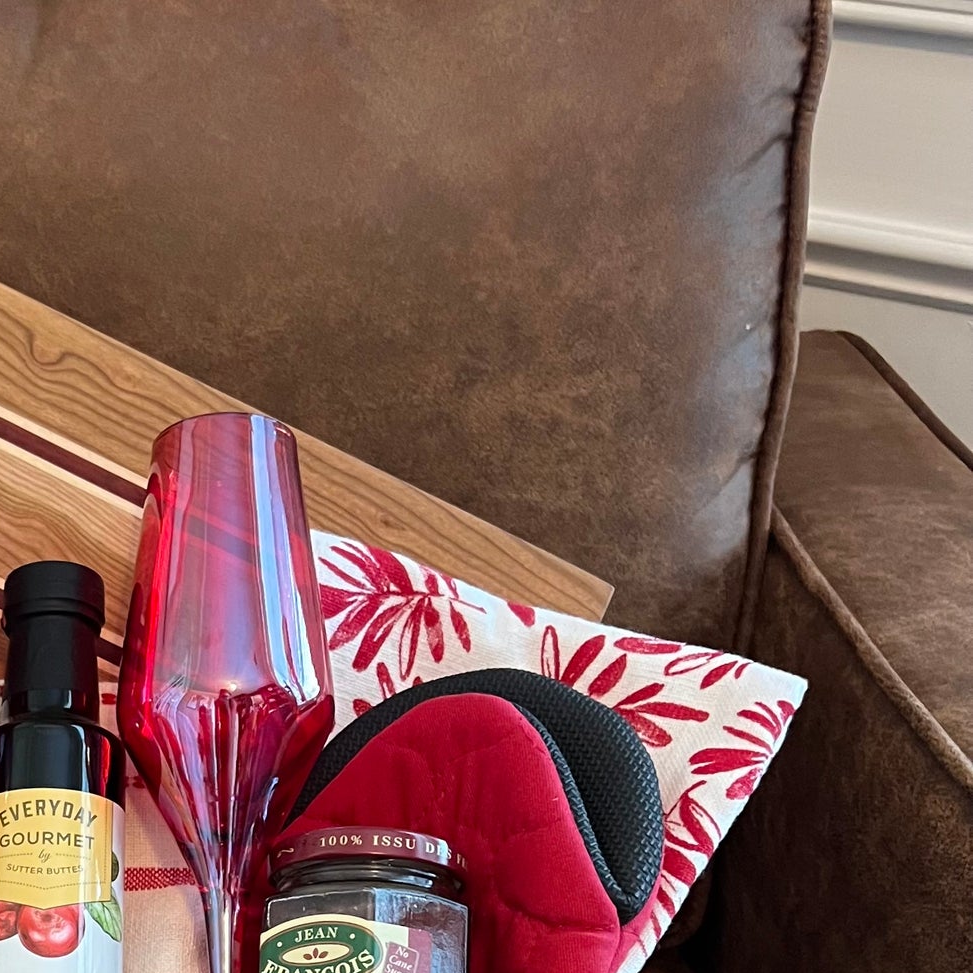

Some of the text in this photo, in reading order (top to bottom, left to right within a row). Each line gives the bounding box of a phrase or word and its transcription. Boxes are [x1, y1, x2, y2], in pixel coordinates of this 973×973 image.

[0, 831, 95, 850] GOURMET
[319, 835, 363, 847] 100%
[372, 835, 417, 850] ISSU
[38, 849, 52, 862] by
[6, 863, 84, 875] SUTTER BUTTES
[294, 926, 339, 943] JEAN
[395, 946, 409, 959] No
[389, 955, 413, 970] Cane
